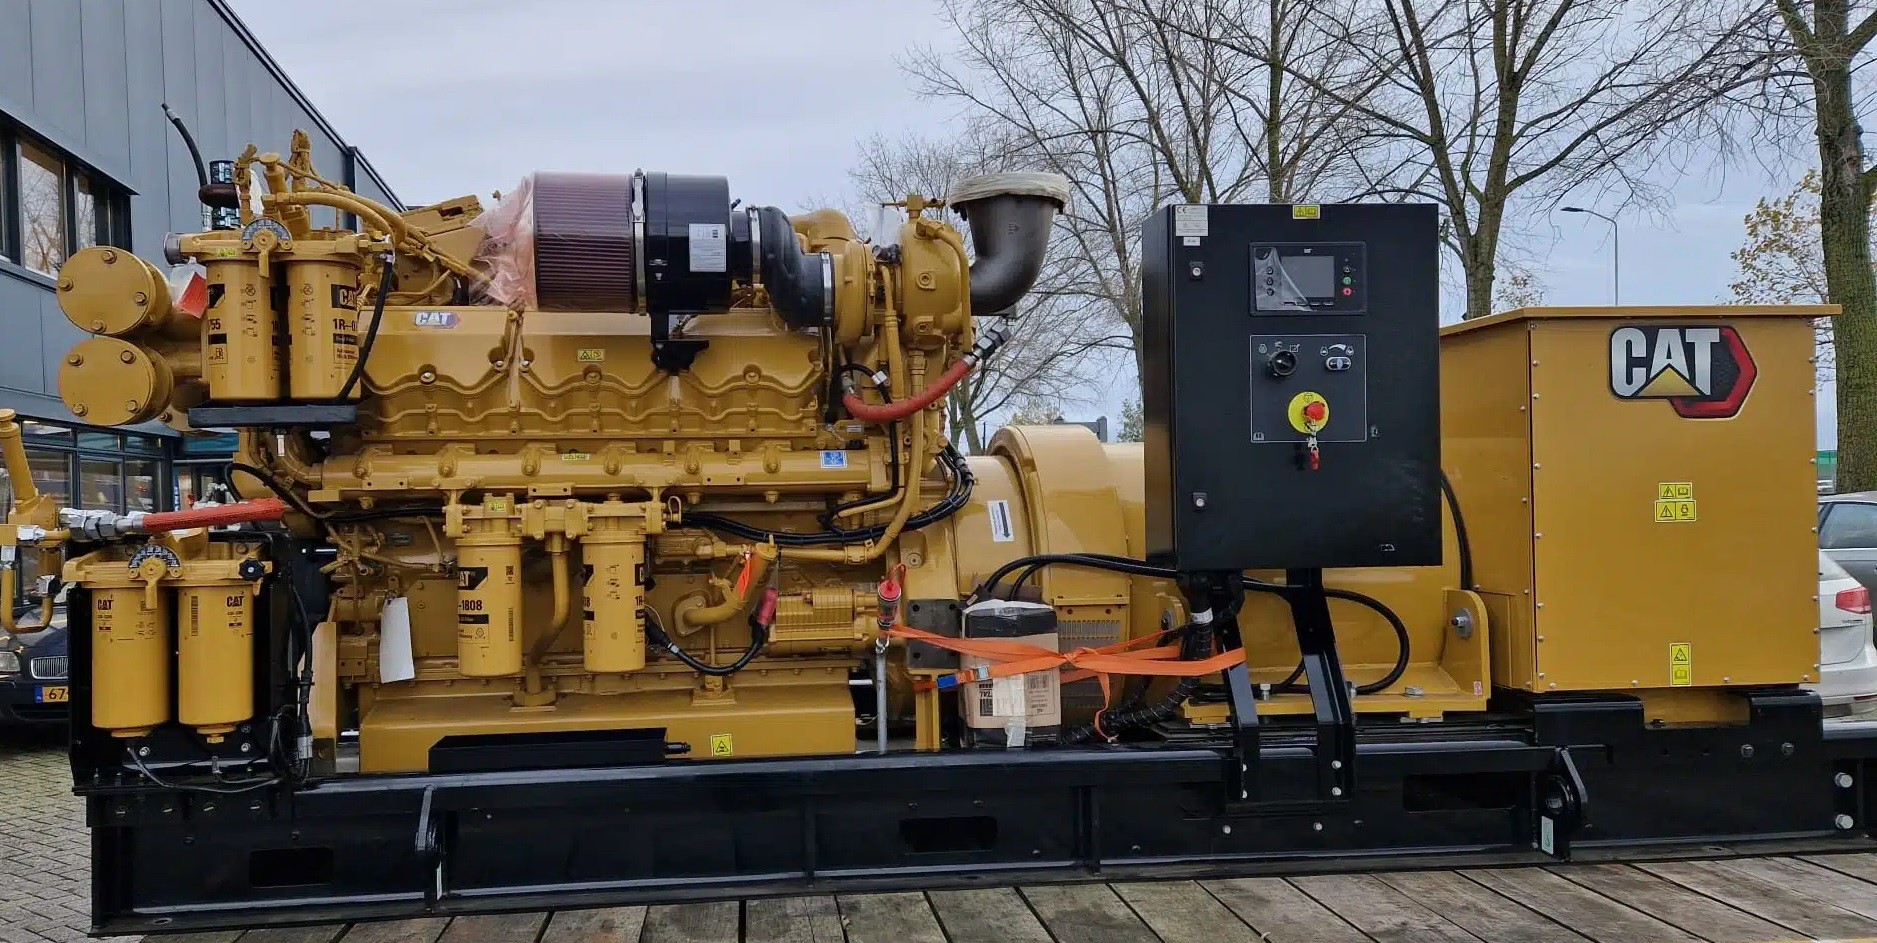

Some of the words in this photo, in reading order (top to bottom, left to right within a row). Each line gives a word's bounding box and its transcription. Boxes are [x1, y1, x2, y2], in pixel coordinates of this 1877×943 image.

[333, 318, 358, 332] 1R-0
[416, 312, 452, 326] CAT
[1611, 327, 1720, 396] CAT
[98, 600, 114, 610] CAT
[227, 596, 244, 607] CAT
